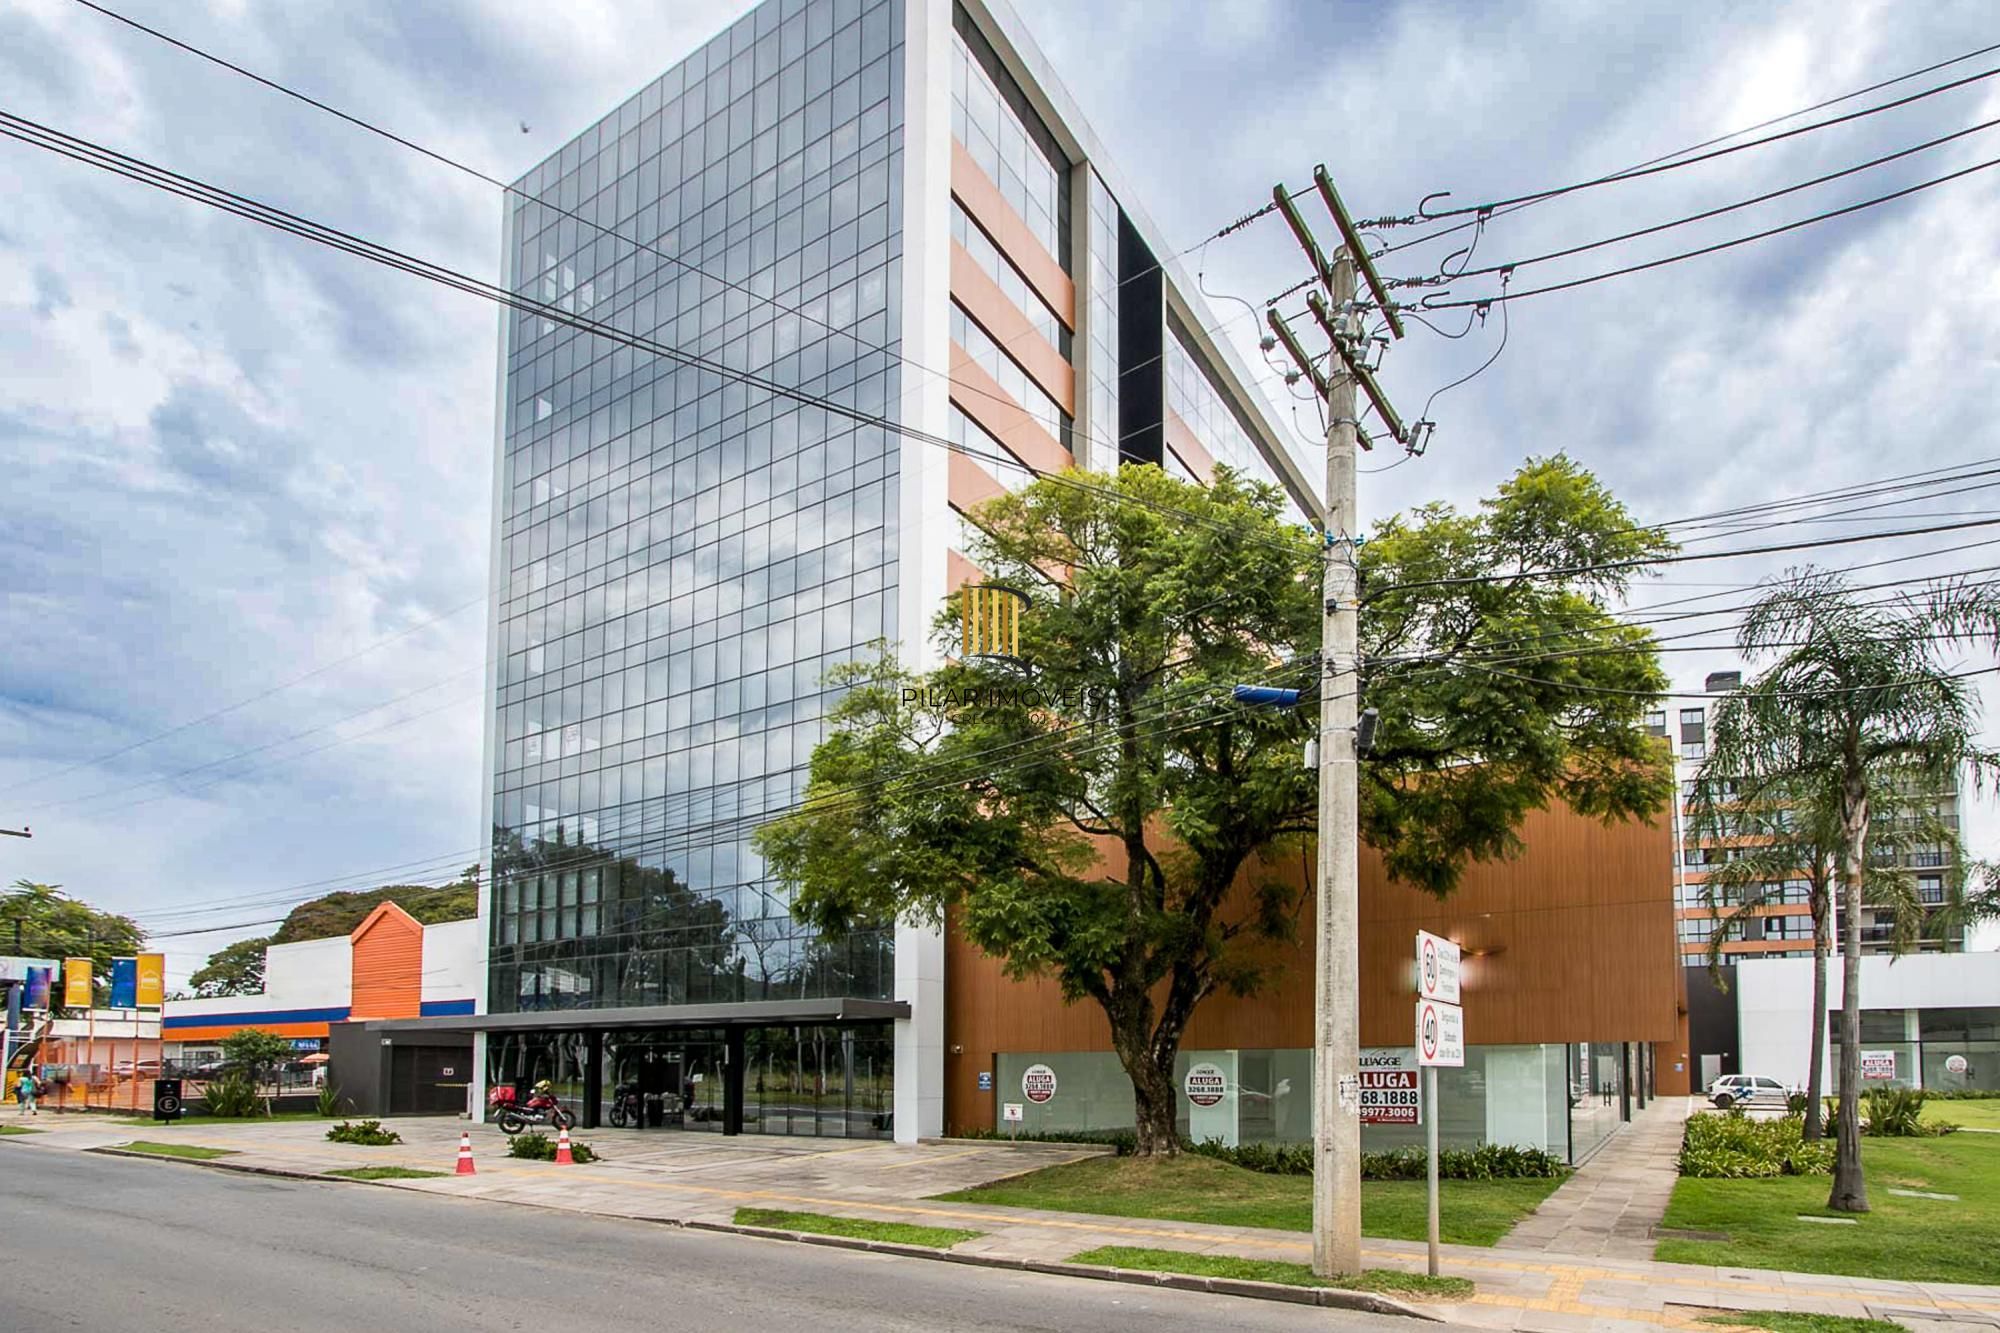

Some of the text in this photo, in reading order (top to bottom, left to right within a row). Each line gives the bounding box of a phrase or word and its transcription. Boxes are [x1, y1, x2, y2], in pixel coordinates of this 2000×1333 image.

[1425, 1019, 1434, 1044] 40
[1028, 1075, 1050, 1083] ALUGA
[1361, 1090, 1418, 1105] 68.1888
[164, 1099, 173, 1109] E
